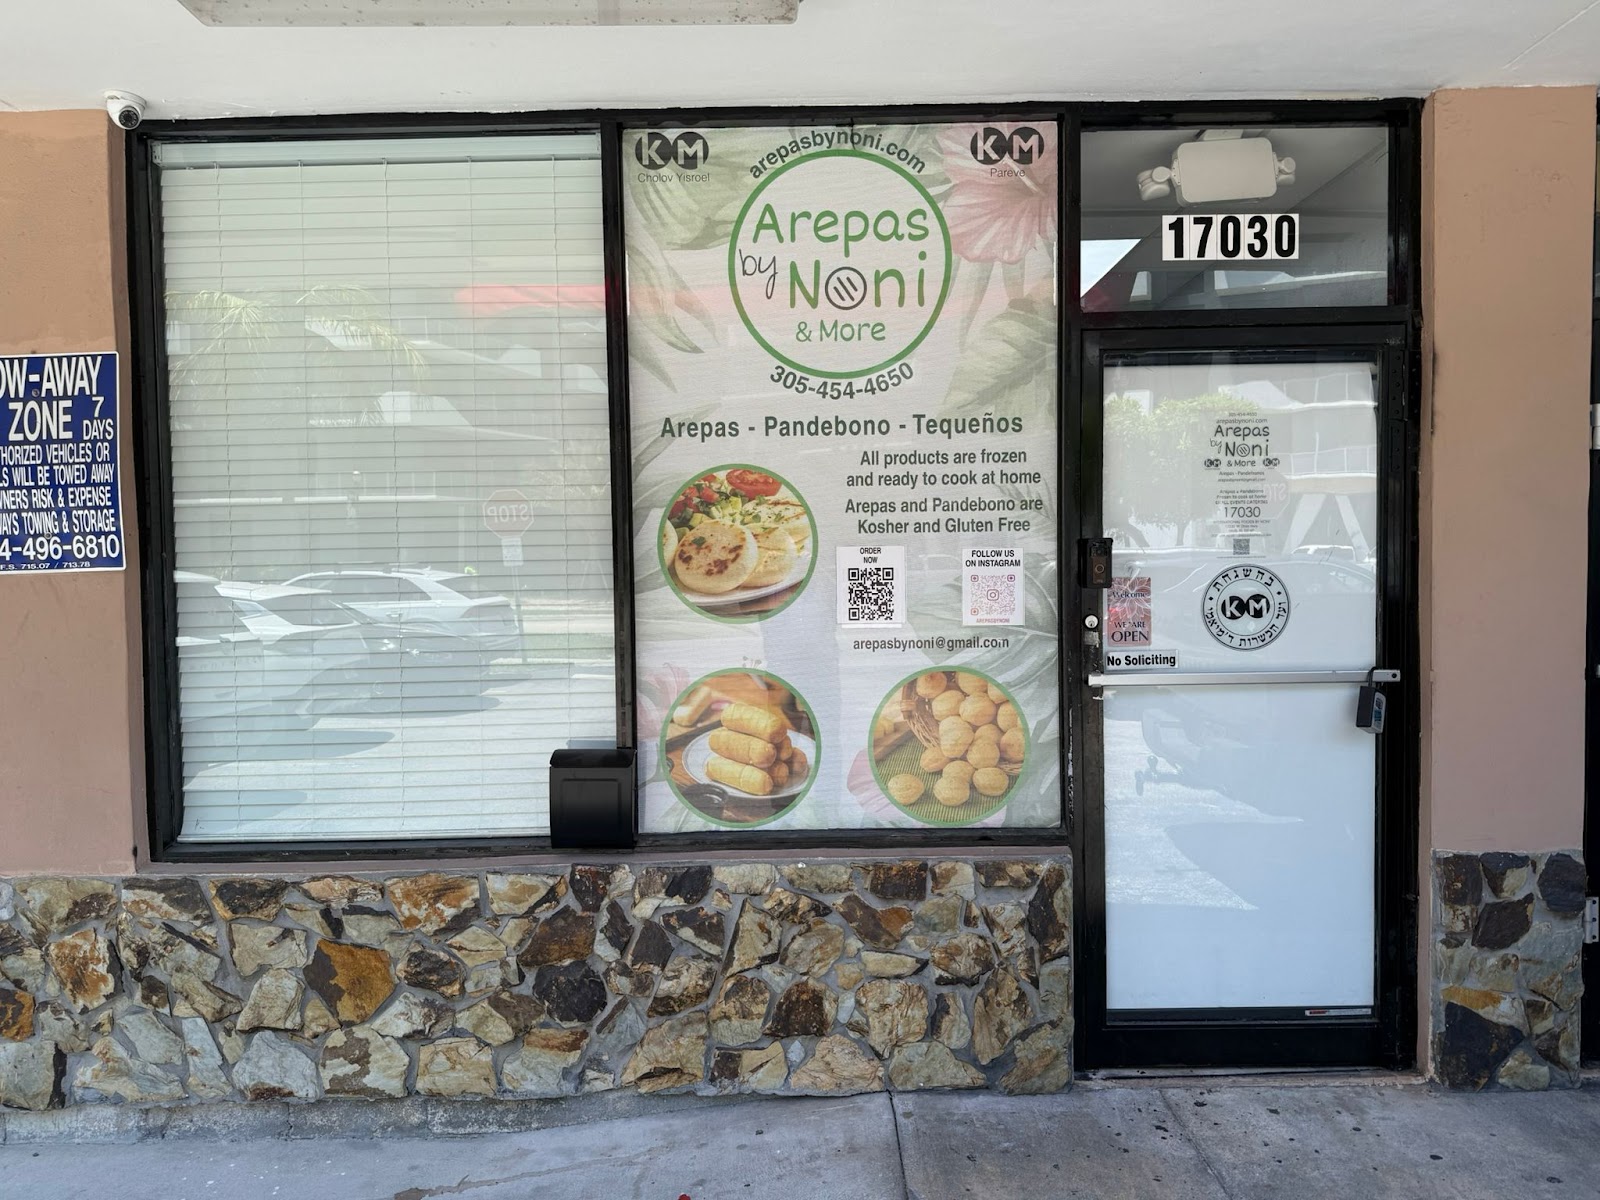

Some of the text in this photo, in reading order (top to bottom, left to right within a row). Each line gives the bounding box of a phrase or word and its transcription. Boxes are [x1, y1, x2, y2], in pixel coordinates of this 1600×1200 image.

[636, 132, 709, 170] KM
[749, 129, 926, 179] arepasbynoni.com
[970, 127, 1044, 165] KM
[638, 173, 710, 183] Cholov Yisroel
[990, 168, 1026, 177] Pareve
[752, 203, 930, 258] Arepas
[1167, 214, 1297, 259] 17030
[738, 248, 928, 311] by Noni
[795, 319, 886, 342] & More
[770, 361, 914, 401] 305-454-4650
[92, 397, 105, 417] 7
[8, 400, 73, 441] ZONE
[83, 419, 114, 441] DAYS
[660, 417, 740, 442] Arepas
[764, 415, 891, 438] Pandebono
[912, 412, 1024, 440] Tequeños
[1214, 425, 1270, 441] Arepas
[0, 442, 110, 466] HORIZED VEHICLES OR
[1210, 438, 1269, 457] by Noni
[860, 449, 1027, 469] All products are frozen
[1227, 459, 1256, 467] & More
[12, 466, 35, 487] WILL
[38, 466, 50, 485] BE
[53, 464, 87, 485] TOWED
[91, 463, 115, 483] AWAY
[846, 469, 1041, 489] and ready to cook at home
[0, 486, 112, 510] NERS RISK & EXPENSE
[845, 496, 1043, 518] Arepas and Pandebono are
[22, 511, 59, 535] TOWING
[62, 510, 70, 533] &
[72, 508, 116, 533] STORAGE
[1225, 506, 1261, 518] 17030
[858, 516, 1031, 535] Kosher and Gluten Free
[859, 547, 882, 555] ORDER
[863, 556, 878, 564] NOW
[971, 549, 1015, 558] FOLLOW US
[21, 562, 51, 570] 715.07
[965, 559, 1021, 567] ON INSTAGRAM
[1112, 591, 1146, 599] Welcome
[1221, 594, 1270, 620] KM
[853, 636, 1009, 652] arepasbynoni@gmail.com
[1111, 631, 1149, 642] OPEN
[1107, 654, 1176, 666] No Soliciting
